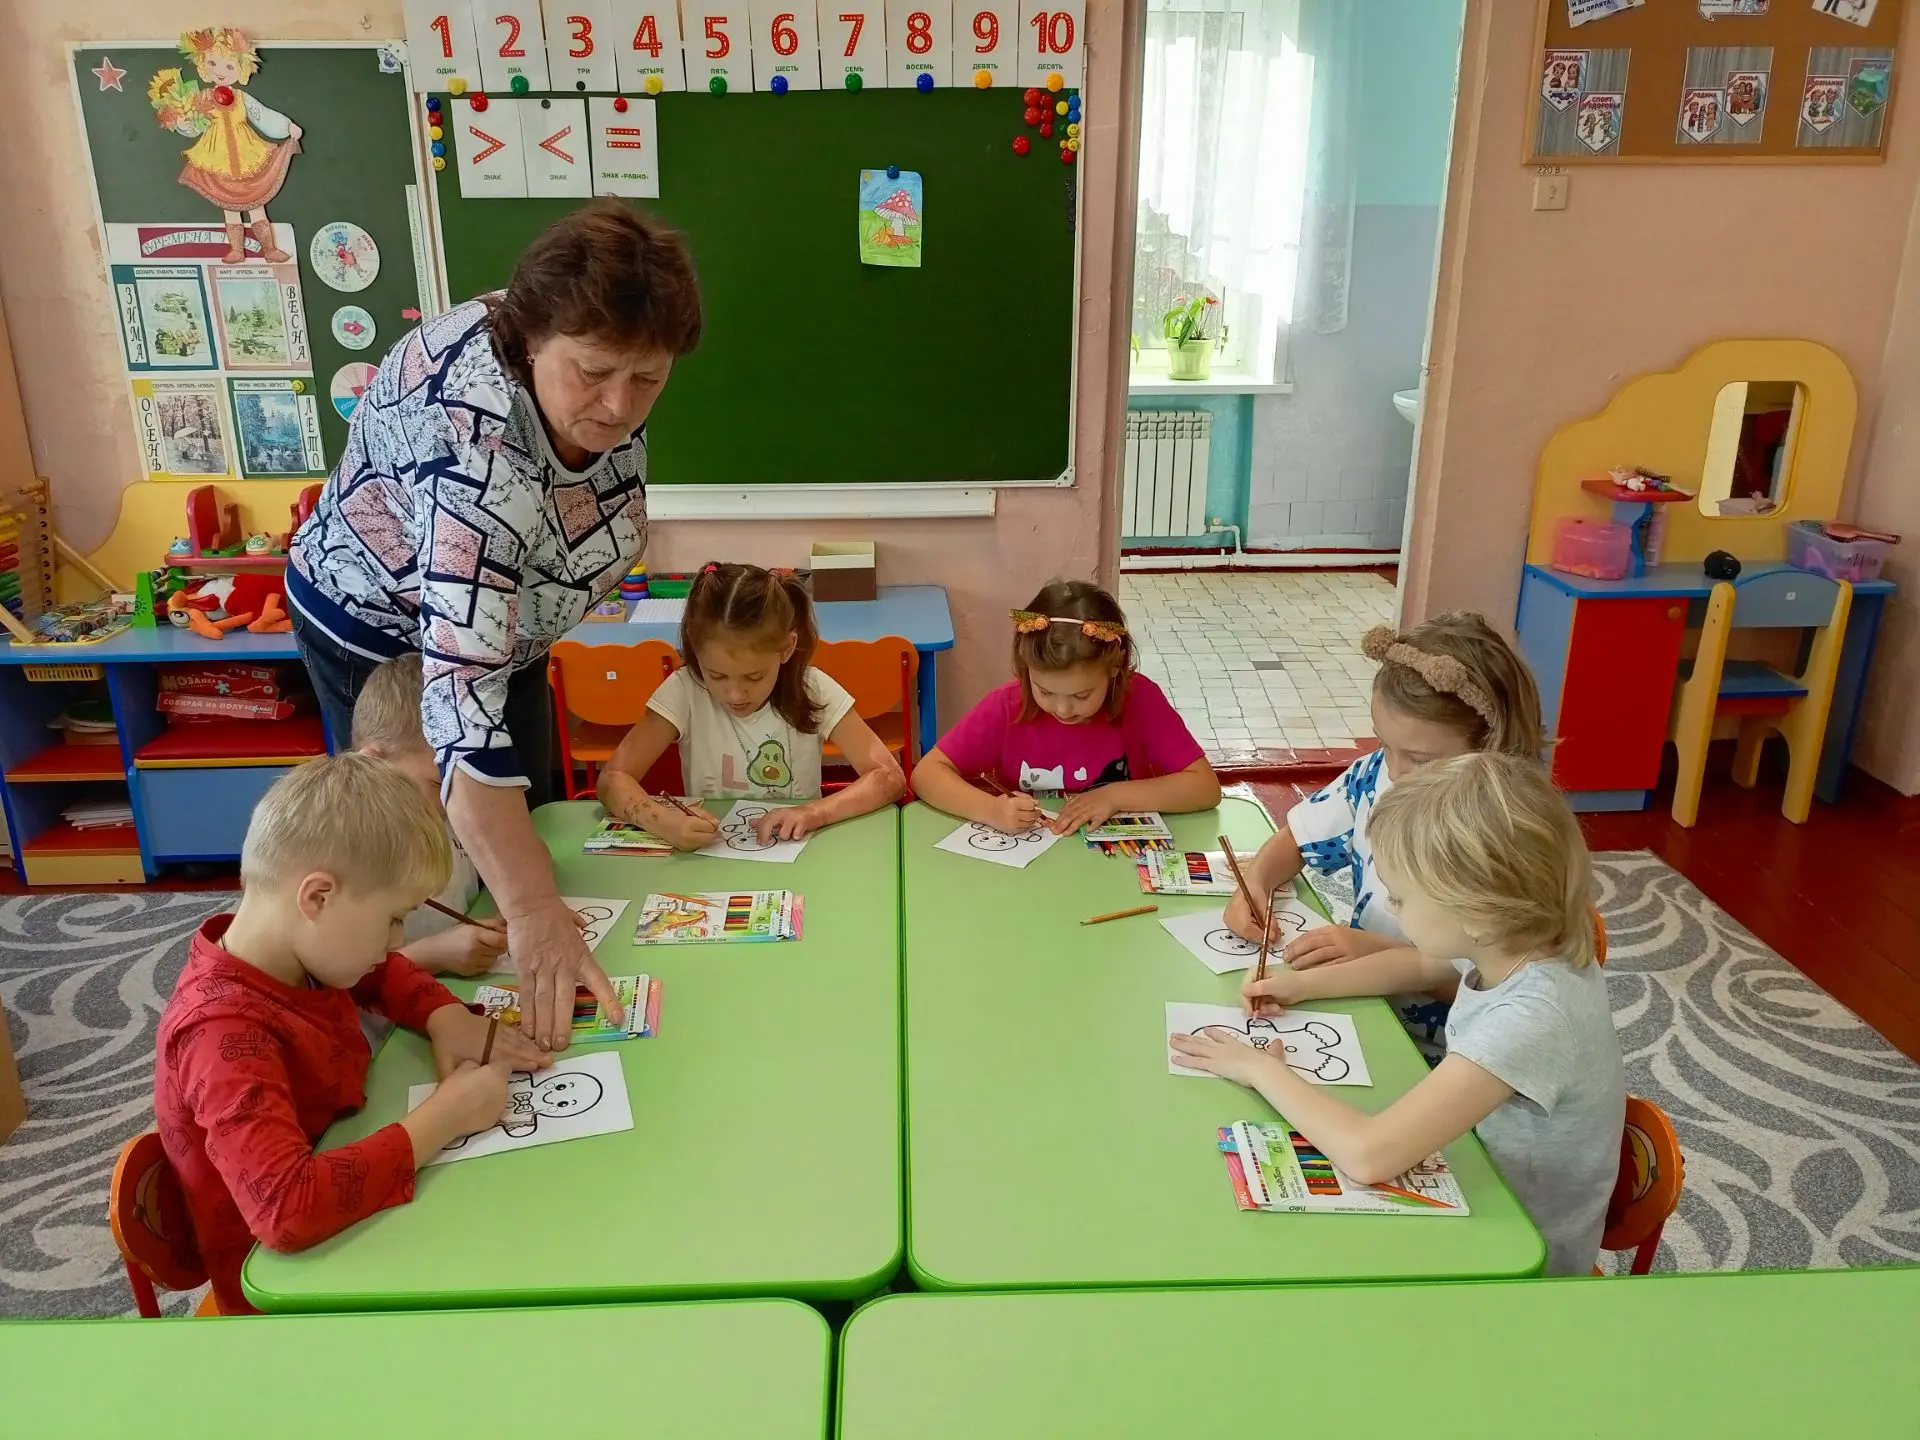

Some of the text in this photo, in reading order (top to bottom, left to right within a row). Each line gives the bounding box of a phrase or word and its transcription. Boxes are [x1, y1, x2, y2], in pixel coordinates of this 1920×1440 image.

[430, 15, 453, 58] 1
[495, 15, 526, 58] 2
[567, 15, 594, 58] 3
[632, 15, 663, 58] 4
[704, 16, 730, 59] 5
[771, 13, 799, 56] 6
[838, 14, 865, 57] 7
[906, 11, 933, 54] 8
[972, 11, 999, 54] 9
[1030, 11, 1075, 54] 10
[637, 67, 665, 75] ЧЕТЫРЕ
[601, 172, 619, 180] ЗНАК
[125, 286, 145, 362] ЗИМА
[286, 285, 306, 361] ВЕСНА
[141, 397, 162, 472] ОСЕНЬ
[304, 397, 320, 469] ЛЕТО
[205, 701, 217, 709] НА
